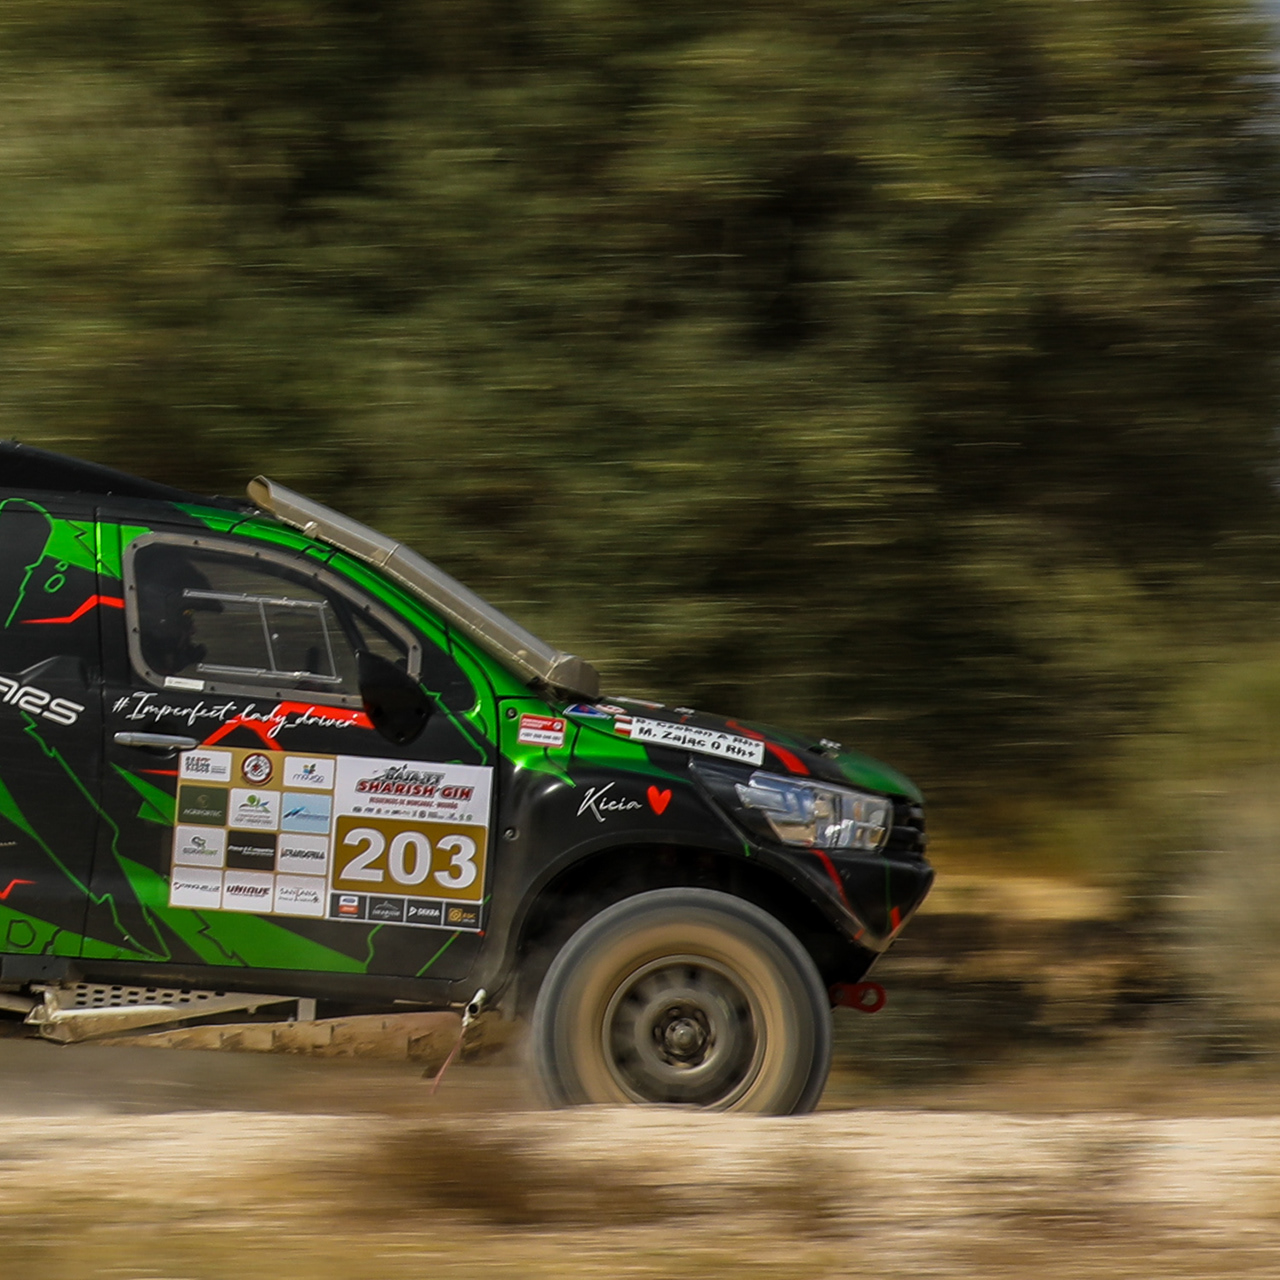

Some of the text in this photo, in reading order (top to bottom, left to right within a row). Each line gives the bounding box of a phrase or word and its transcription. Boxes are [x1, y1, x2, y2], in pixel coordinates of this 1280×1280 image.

[638, 726, 657, 738] M.
[725, 744, 757, 758] Rh+
[357, 780, 474, 801] SHARISH GIN
[576, 781, 643, 823] Kicia
[339, 827, 478, 889] 203
[226, 884, 270, 896] UNIQUE
